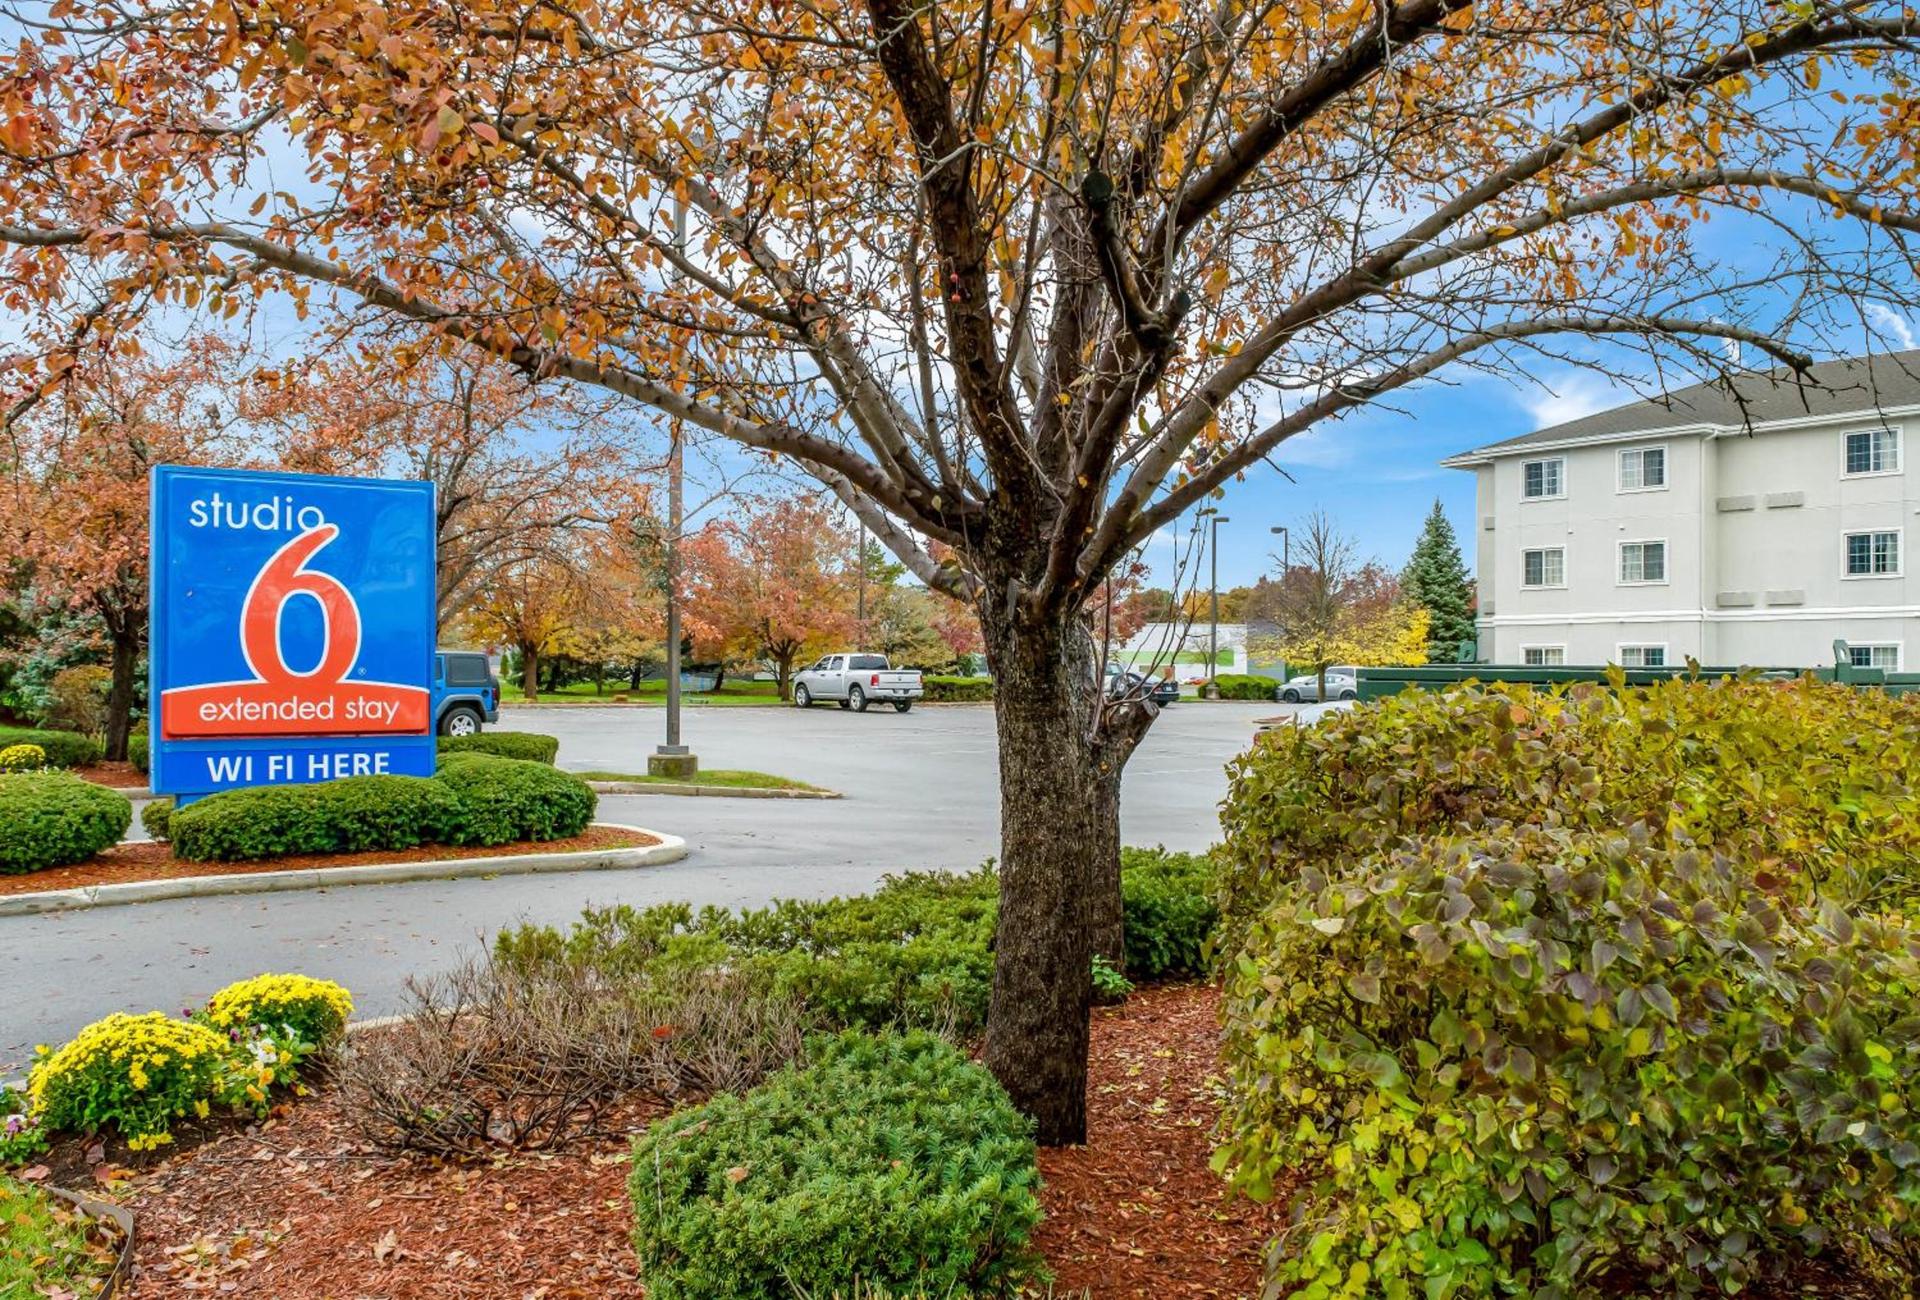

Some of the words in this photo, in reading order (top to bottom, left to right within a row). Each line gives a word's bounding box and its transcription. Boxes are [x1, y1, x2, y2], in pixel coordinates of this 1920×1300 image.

[189, 492, 324, 530] studio
[240, 523, 362, 683] 6
[200, 696, 334, 722] extended
[345, 696, 400, 725] stay
[207, 756, 252, 783] WI
[268, 755, 294, 780] FI
[308, 752, 390, 779] HERE
